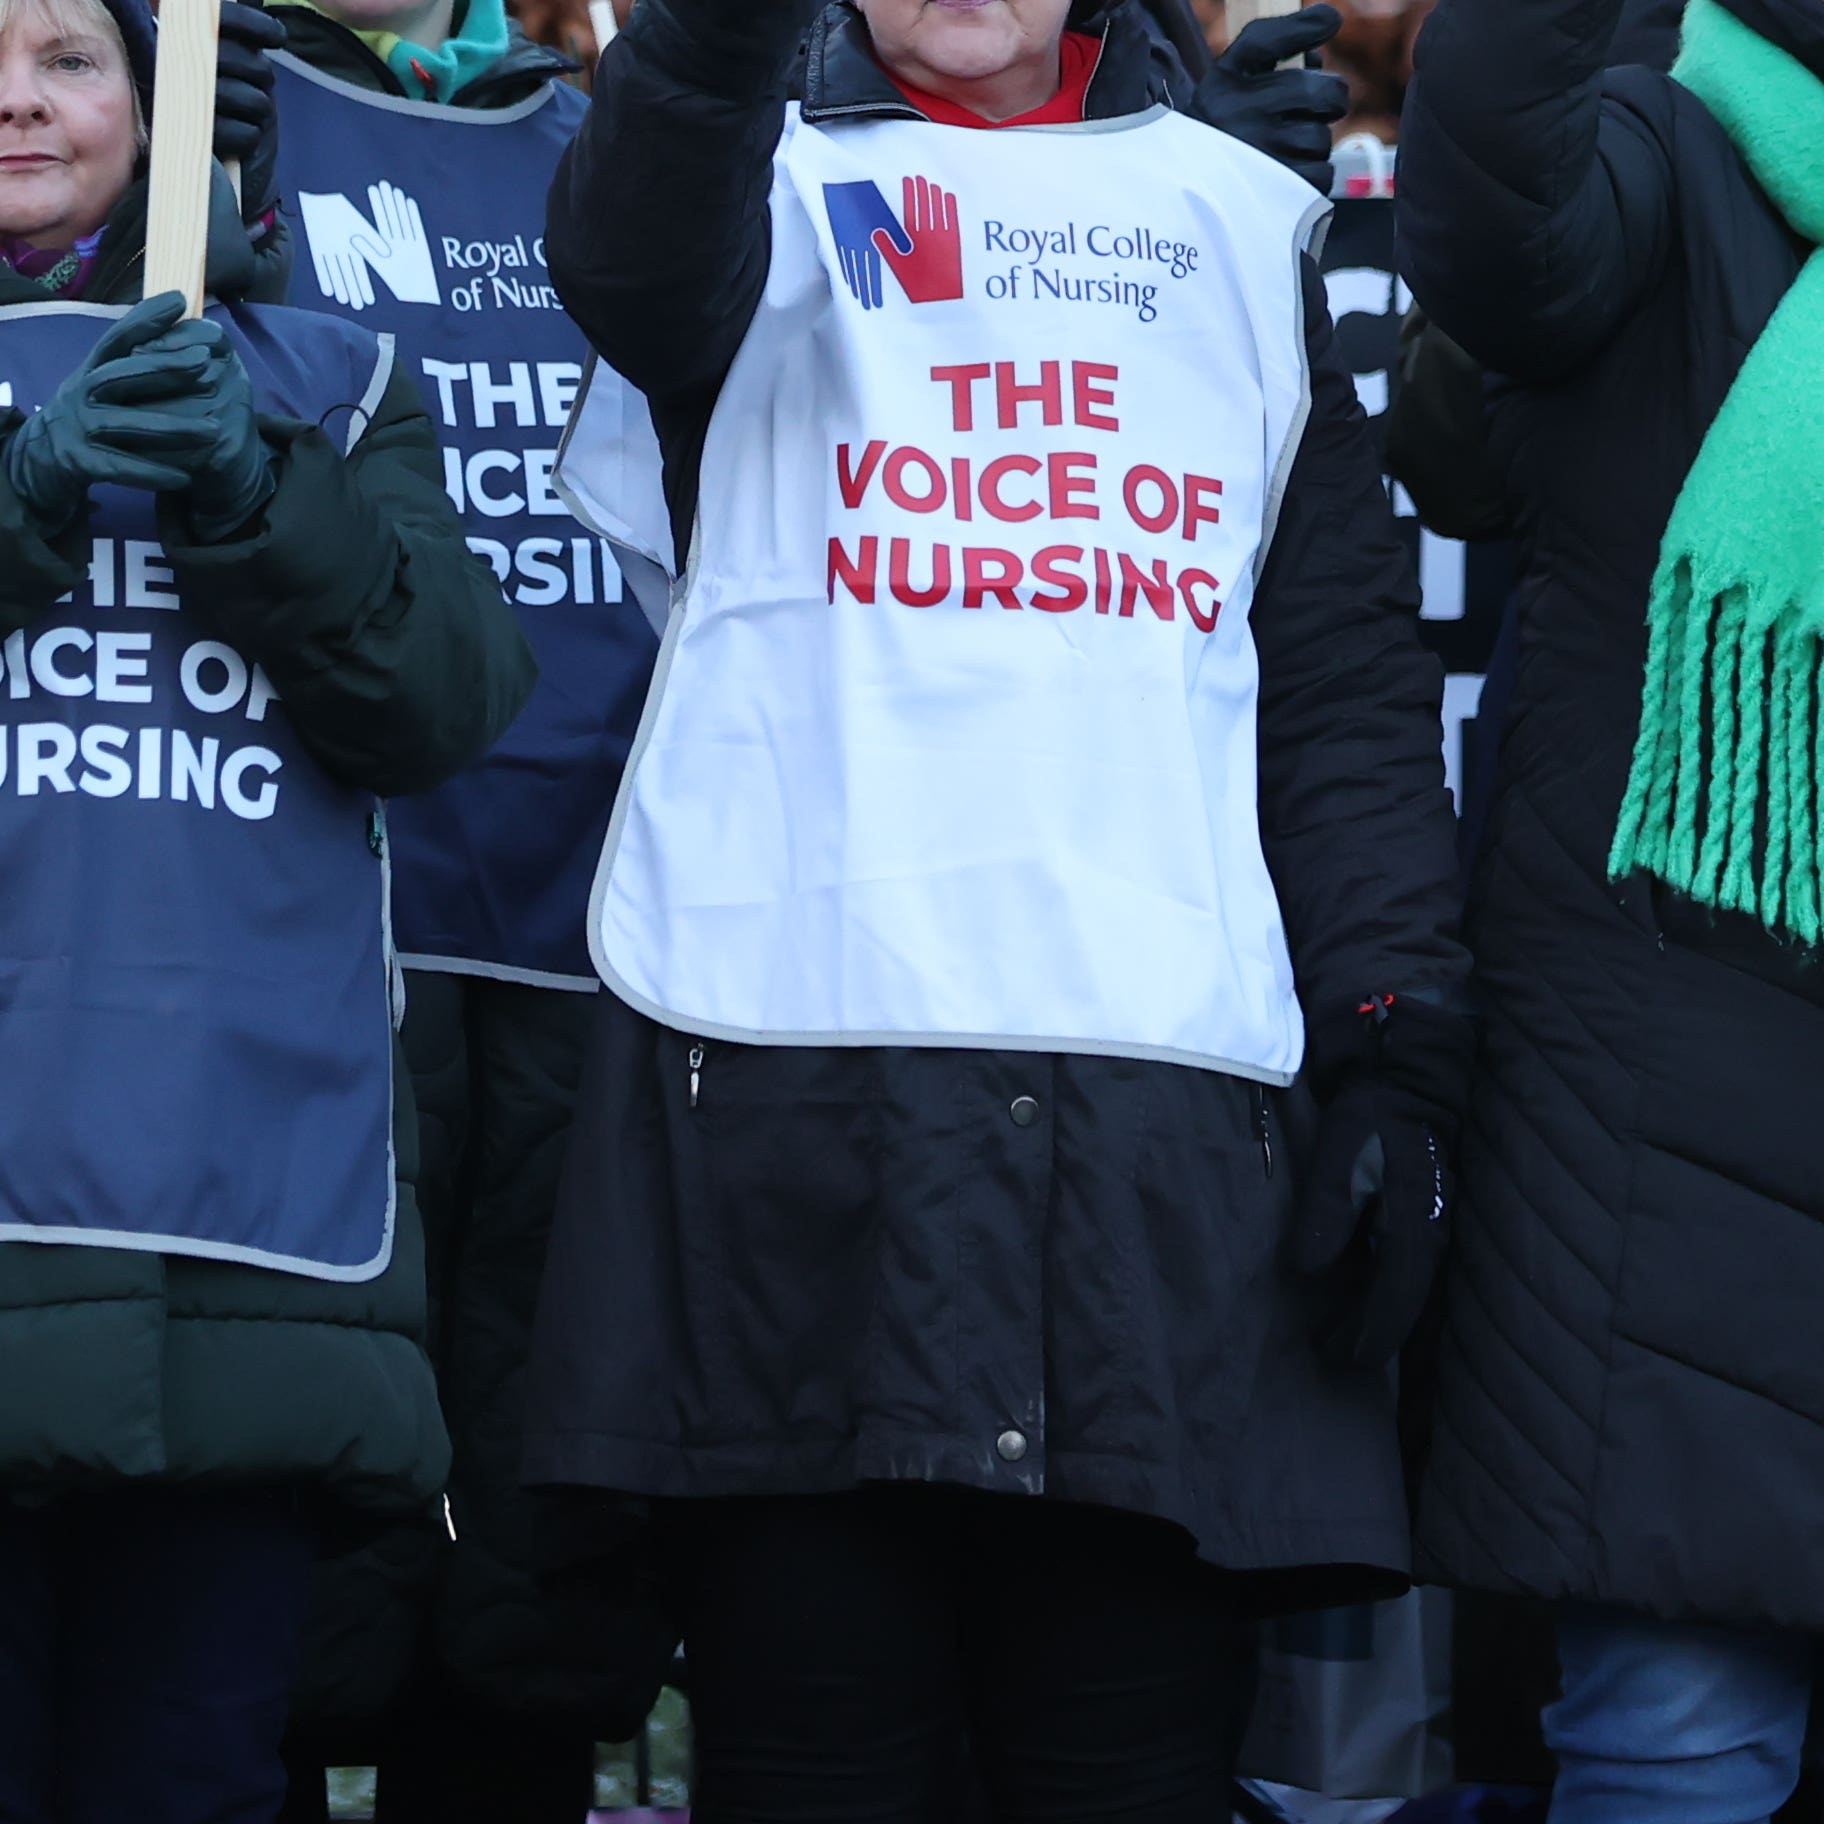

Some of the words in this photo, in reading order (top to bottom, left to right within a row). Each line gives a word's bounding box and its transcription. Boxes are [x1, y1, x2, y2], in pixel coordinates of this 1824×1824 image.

[441, 236, 528, 276] Royal
[983, 221, 1075, 266] Royal
[1086, 225, 1199, 278] College
[452, 276, 483, 312] of
[494, 277, 564, 311] Nurs
[985, 267, 1020, 299] of
[1033, 269, 1158, 322] Nursing
[930, 359, 1120, 433] THE
[442, 446, 576, 518] ICE
[836, 440, 1100, 523] VOICE
[1122, 463, 1223, 542] OF
[827, 534, 1221, 634] NURSING
